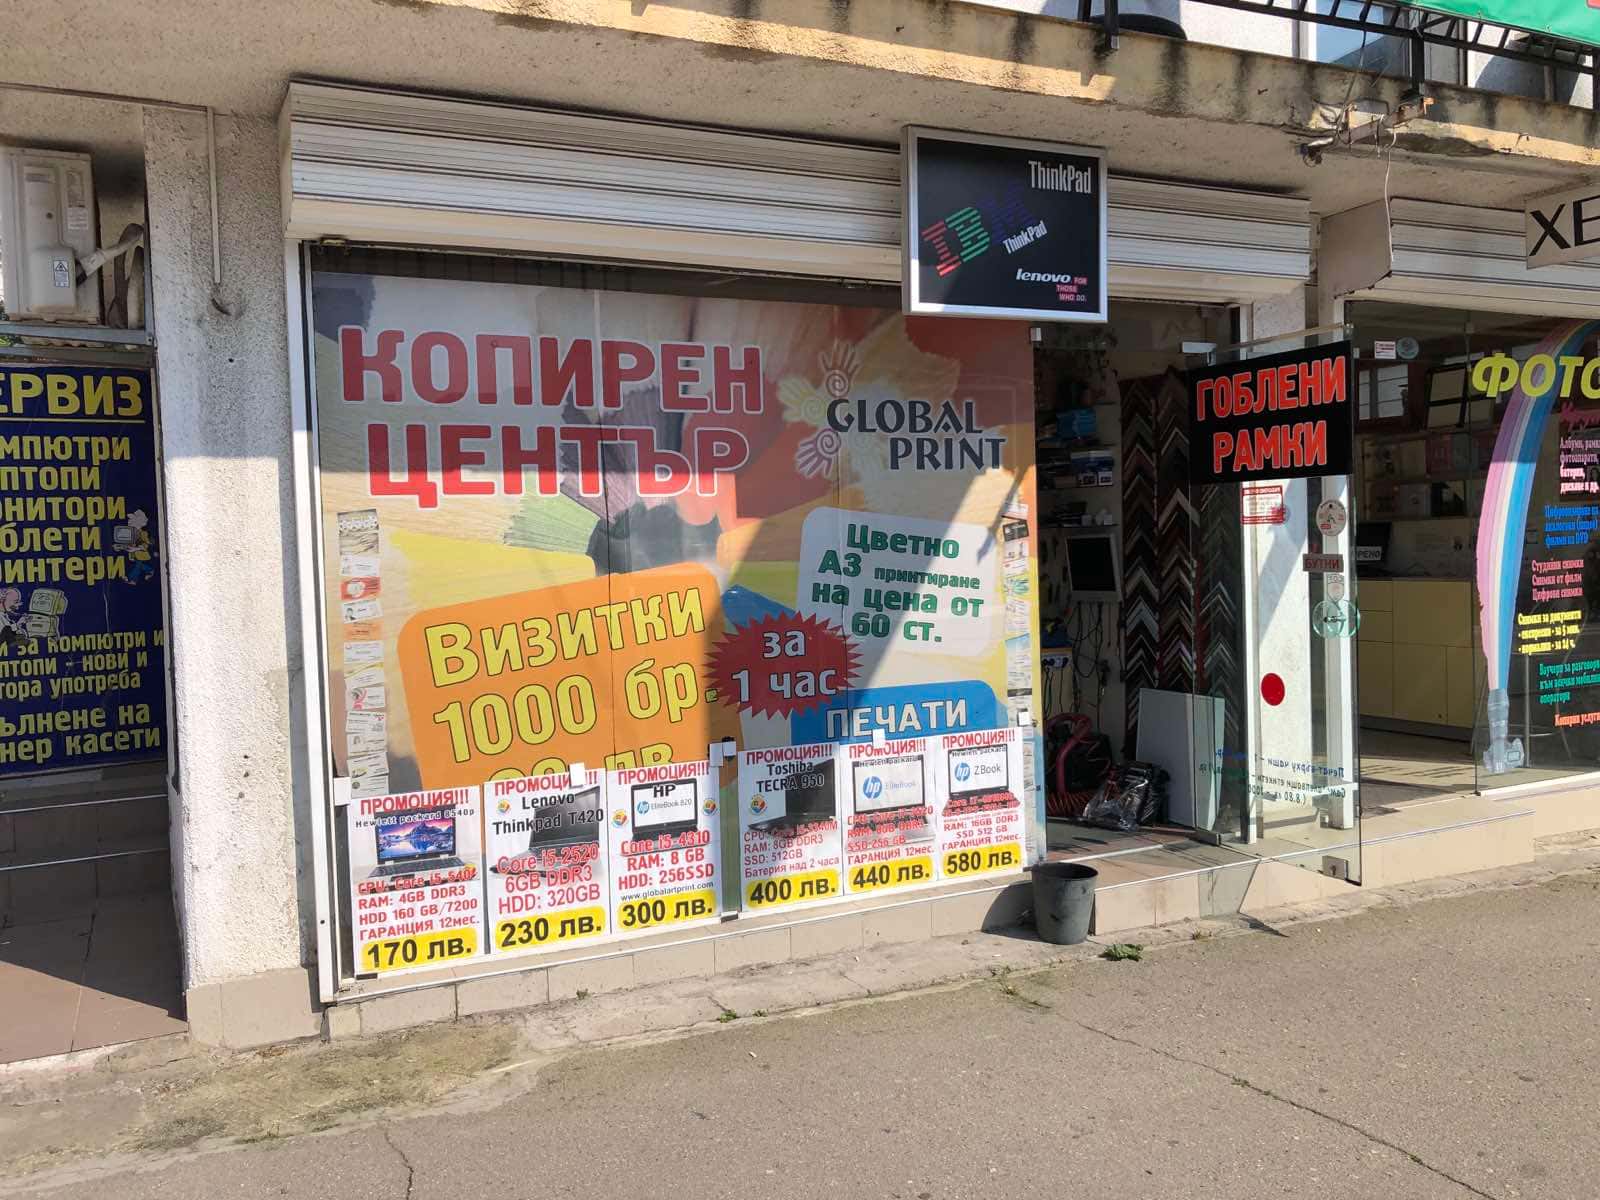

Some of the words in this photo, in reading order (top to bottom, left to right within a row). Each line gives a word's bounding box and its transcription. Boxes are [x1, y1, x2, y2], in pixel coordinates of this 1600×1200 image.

[1028, 160, 1091, 193] ThinkPad
[1002, 220, 1048, 254] ThinkPad
[1016, 268, 1071, 283] lenovo
[338, 325, 764, 414] КОПИРЕН
[1196, 355, 1346, 421] ГОБЛЕНИ
[827, 399, 983, 433] GLOBAL
[890, 437, 1006, 470] PRINT
[1213, 420, 1327, 473] РАМКИ
[366, 423, 750, 510] ЦЕНТЪР
[0, 496, 126, 525] нитори
[847, 523, 960, 558] Цветно
[0, 554, 126, 586] интери
[818, 550, 862, 577] А3
[874, 566, 980, 589] принтиране
[812, 583, 849, 606] на
[864, 588, 938, 612] цена
[951, 597, 984, 617] от
[424, 587, 705, 688] Визитки
[851, 612, 890, 637] 60
[903, 620, 942, 642] ст.
[48, 631, 146, 653] компютри
[762, 631, 807, 658] за
[82, 653, 129, 672] нови
[137, 651, 148, 668] и
[50, 670, 141, 700] употреба
[732, 673, 749, 703] 1
[770, 668, 838, 699] час
[118, 704, 151, 726] на
[433, 675, 597, 763] 1000
[625, 659, 718, 724] бр.
[826, 698, 968, 739] ПЕЧАТИ
[65, 727, 161, 756] касети
[942, 729, 1015, 749] ПРОМОЦИЯ!!!
[746, 744, 833, 766] ПРОМОЦИЯ!!!
[767, 760, 814, 776] Toshiba
[494, 771, 598, 797] ПРОМОЦИ!!!
[617, 762, 711, 786] ПРОМОЦИЯ!!!
[756, 777, 800, 793] TECRA
[360, 789, 469, 815] ПРОМОЦИЯ!!!
[522, 793, 576, 810] Lenovo
[653, 784, 676, 799] HP
[493, 814, 561, 835] Thinkpad
[568, 808, 604, 825] T420
[621, 841, 654, 856] Core
[744, 841, 770, 854] RAM:
[773, 838, 794, 850] 8GB
[796, 834, 824, 847] DDR3
[848, 848, 901, 865] ГАРАНЦИЯ
[942, 836, 991, 851] ГАРАНЦИЯ
[497, 855, 537, 873] Core
[627, 856, 665, 872] RAM:
[670, 852, 680, 865] 8
[685, 848, 705, 864] GB
[744, 854, 769, 866] SSD:
[772, 849, 803, 862] 512GB
[744, 865, 787, 879] Батерия
[789, 862, 807, 872] над
[810, 858, 815, 868] 2
[817, 857, 840, 866] часа
[947, 851, 982, 874] 580
[505, 875, 541, 893] 6GB
[547, 865, 593, 888] DDR3
[618, 874, 653, 891] HDD:
[659, 863, 715, 884] 256SSD
[853, 864, 890, 888] 440
[358, 896, 393, 909] RAM:
[400, 891, 425, 905] 4GB
[431, 886, 466, 900] DDR3
[498, 893, 541, 915] HDD:
[547, 884, 600, 907] 320GB
[621, 880, 714, 902] www.globalartprint.com
[751, 879, 792, 904] 400
[359, 911, 387, 926] HDD
[393, 907, 414, 920] 160
[420, 899, 478, 916] GB/7200
[622, 899, 666, 927] 300
[359, 919, 434, 940] ГАРАНЦИЯ
[440, 915, 480, 929] 12мес.
[500, 917, 549, 947] 230
[367, 938, 417, 968] 170
